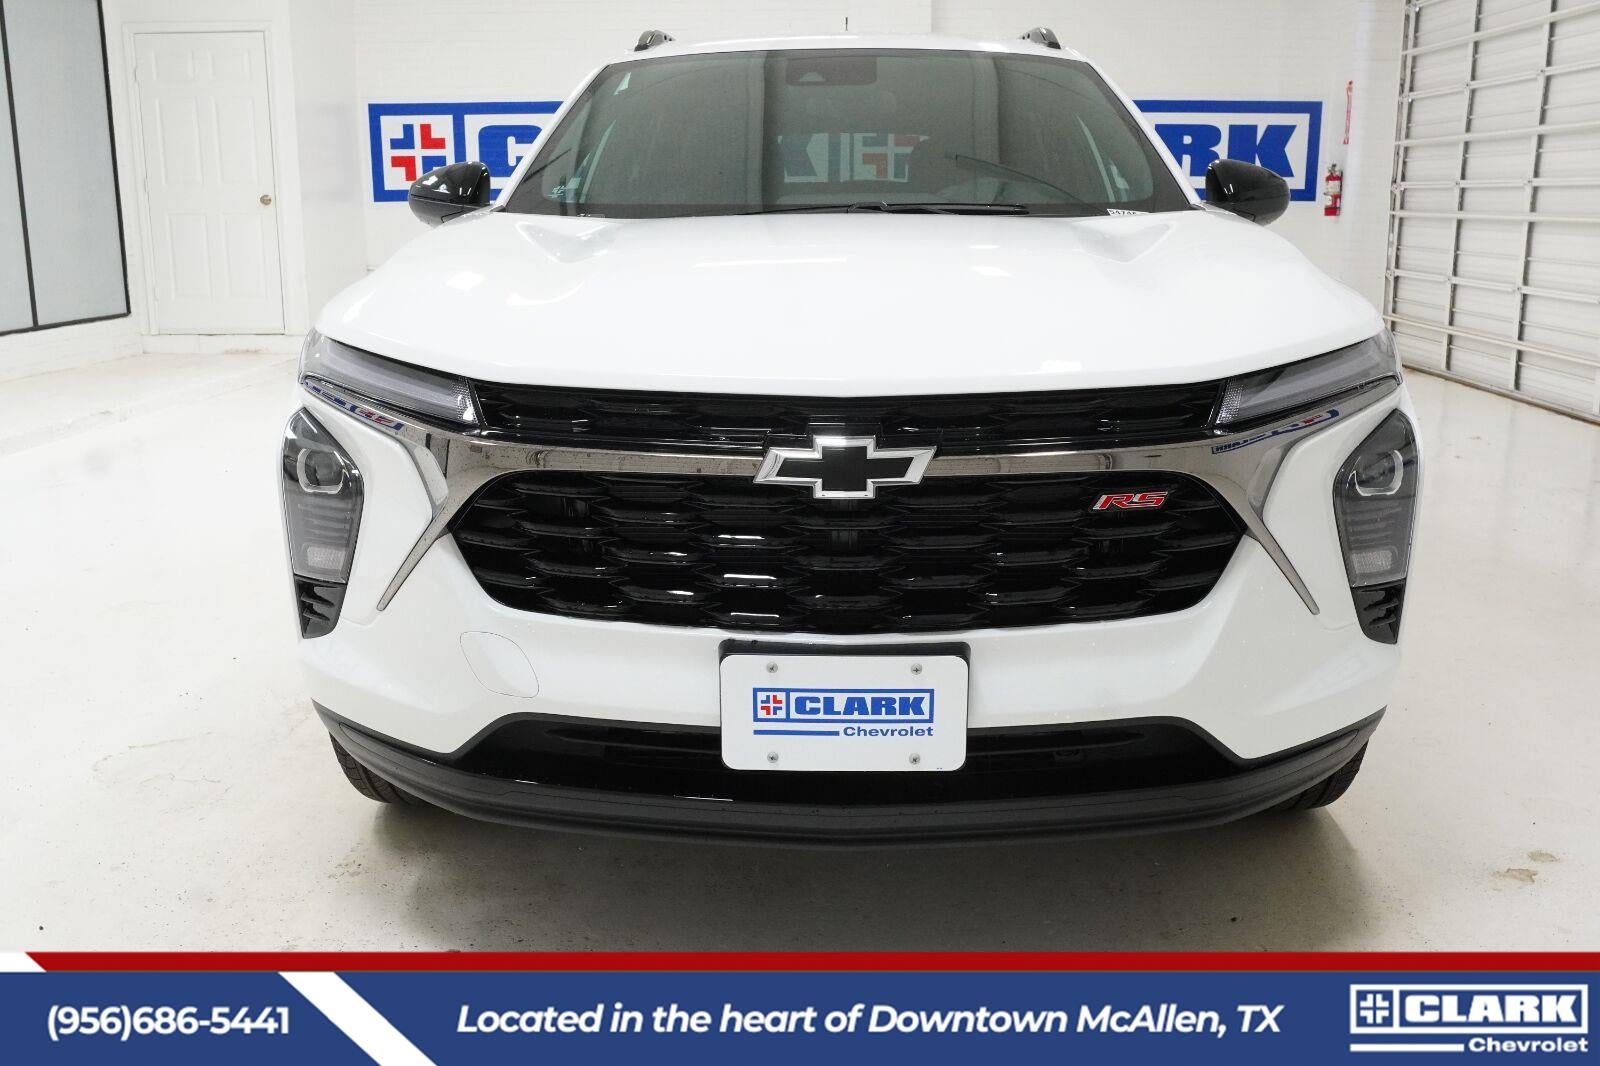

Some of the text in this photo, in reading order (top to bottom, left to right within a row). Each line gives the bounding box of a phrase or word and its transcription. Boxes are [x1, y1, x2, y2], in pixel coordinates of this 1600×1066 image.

[1092, 491, 1169, 511] RS
[794, 696, 926, 716] CLARK
[843, 726, 934, 738] Chevrolet
